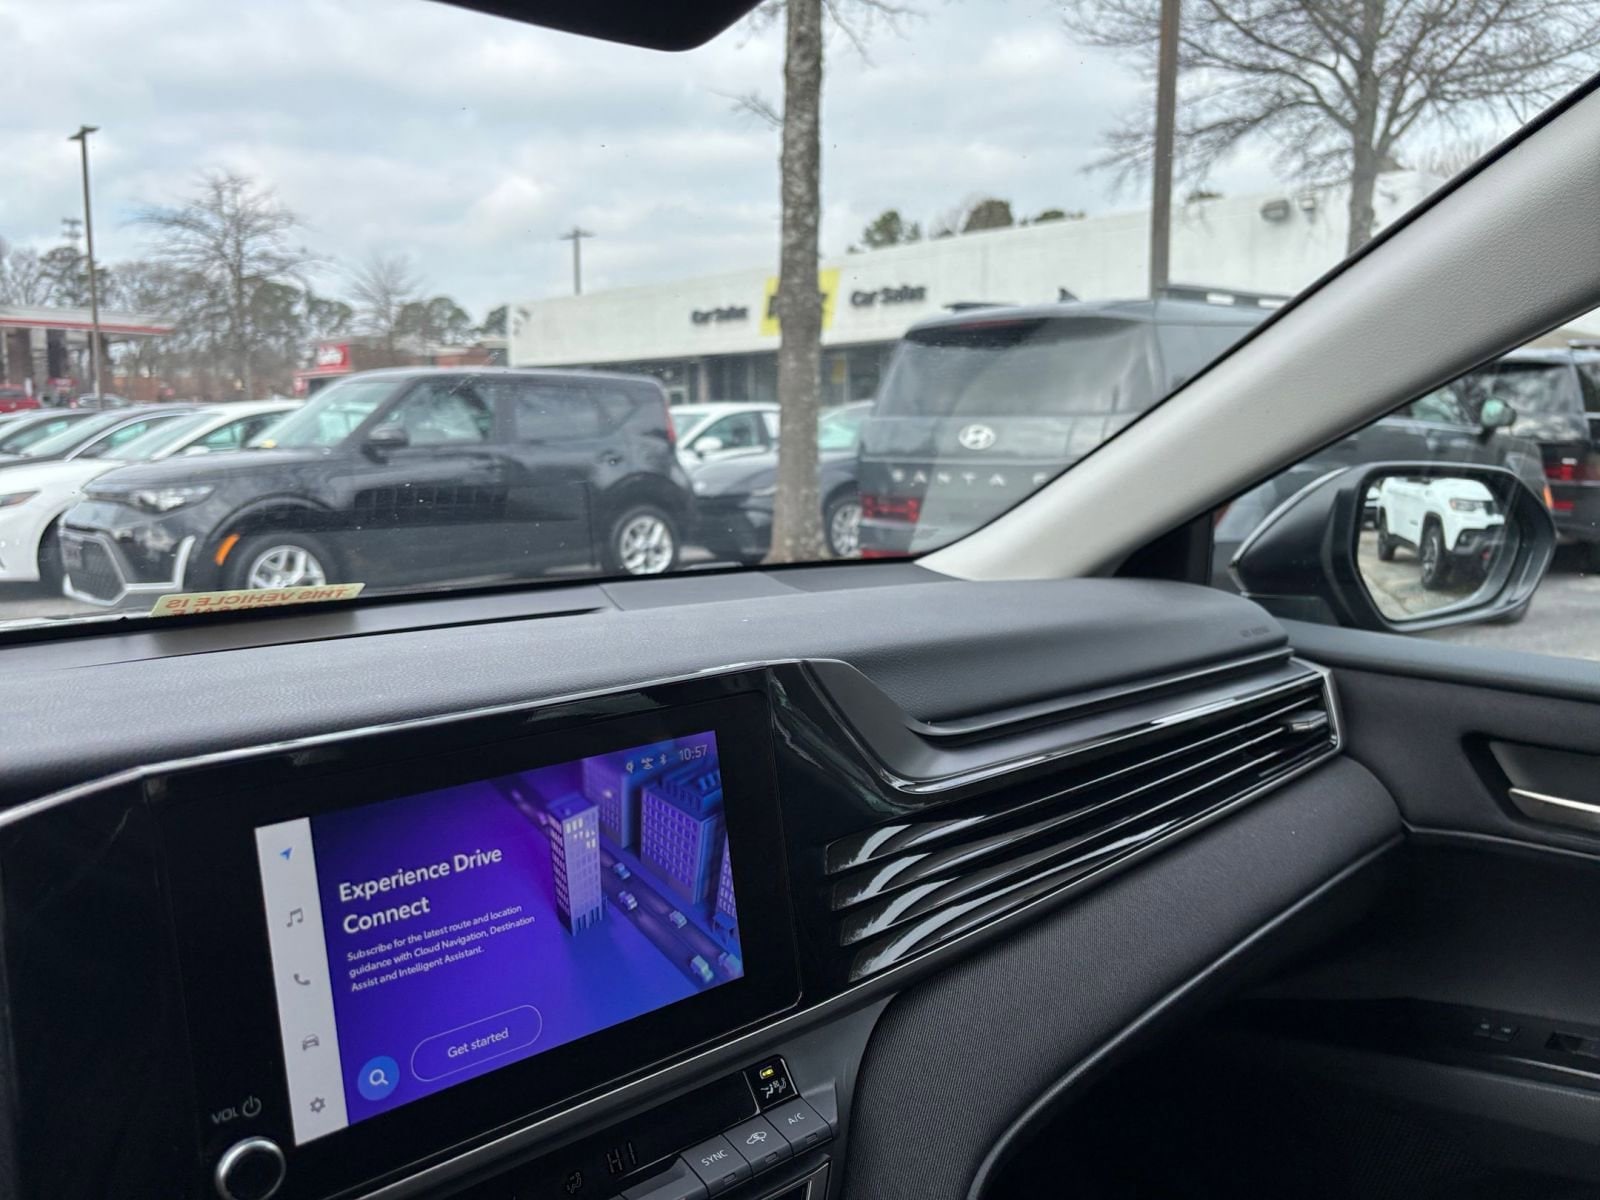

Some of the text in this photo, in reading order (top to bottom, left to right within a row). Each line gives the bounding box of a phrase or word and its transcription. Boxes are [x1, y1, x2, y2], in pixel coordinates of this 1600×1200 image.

[891, 469, 1006, 487] SANTA
[679, 744, 708, 761] 10:57
[338, 848, 503, 902] Experience Drive
[343, 896, 431, 934] Connect
[347, 905, 522, 961] Subscribe for the latest route and location
[349, 916, 535, 979] guidance with Cloud Navigation, Destination
[351, 946, 485, 992] Assist and Intelligent Assistant.
[447, 1027, 510, 1058] Get started
[211, 1107, 239, 1124] VOL
[787, 1112, 805, 1125] A/C
[701, 1149, 728, 1166] SYNC
